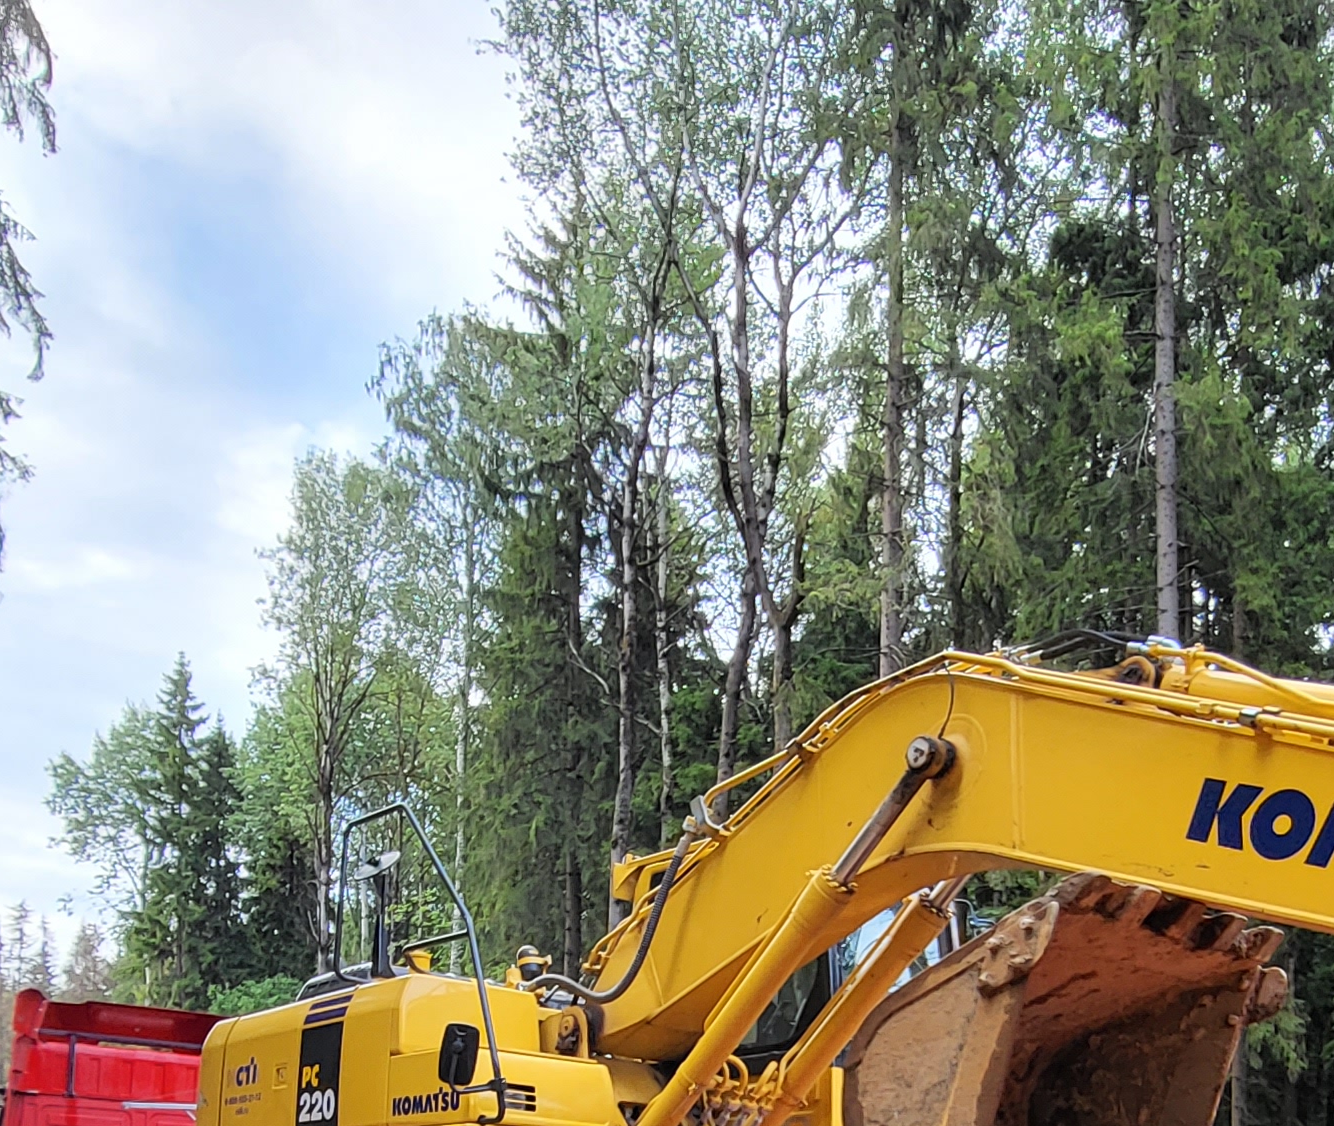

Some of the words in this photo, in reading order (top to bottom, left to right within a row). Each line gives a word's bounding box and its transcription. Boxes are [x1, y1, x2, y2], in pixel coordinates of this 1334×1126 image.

[301, 1063, 320, 1088] PC
[298, 1088, 336, 1123] 220
[392, 1086, 460, 1117] KOMATSU
